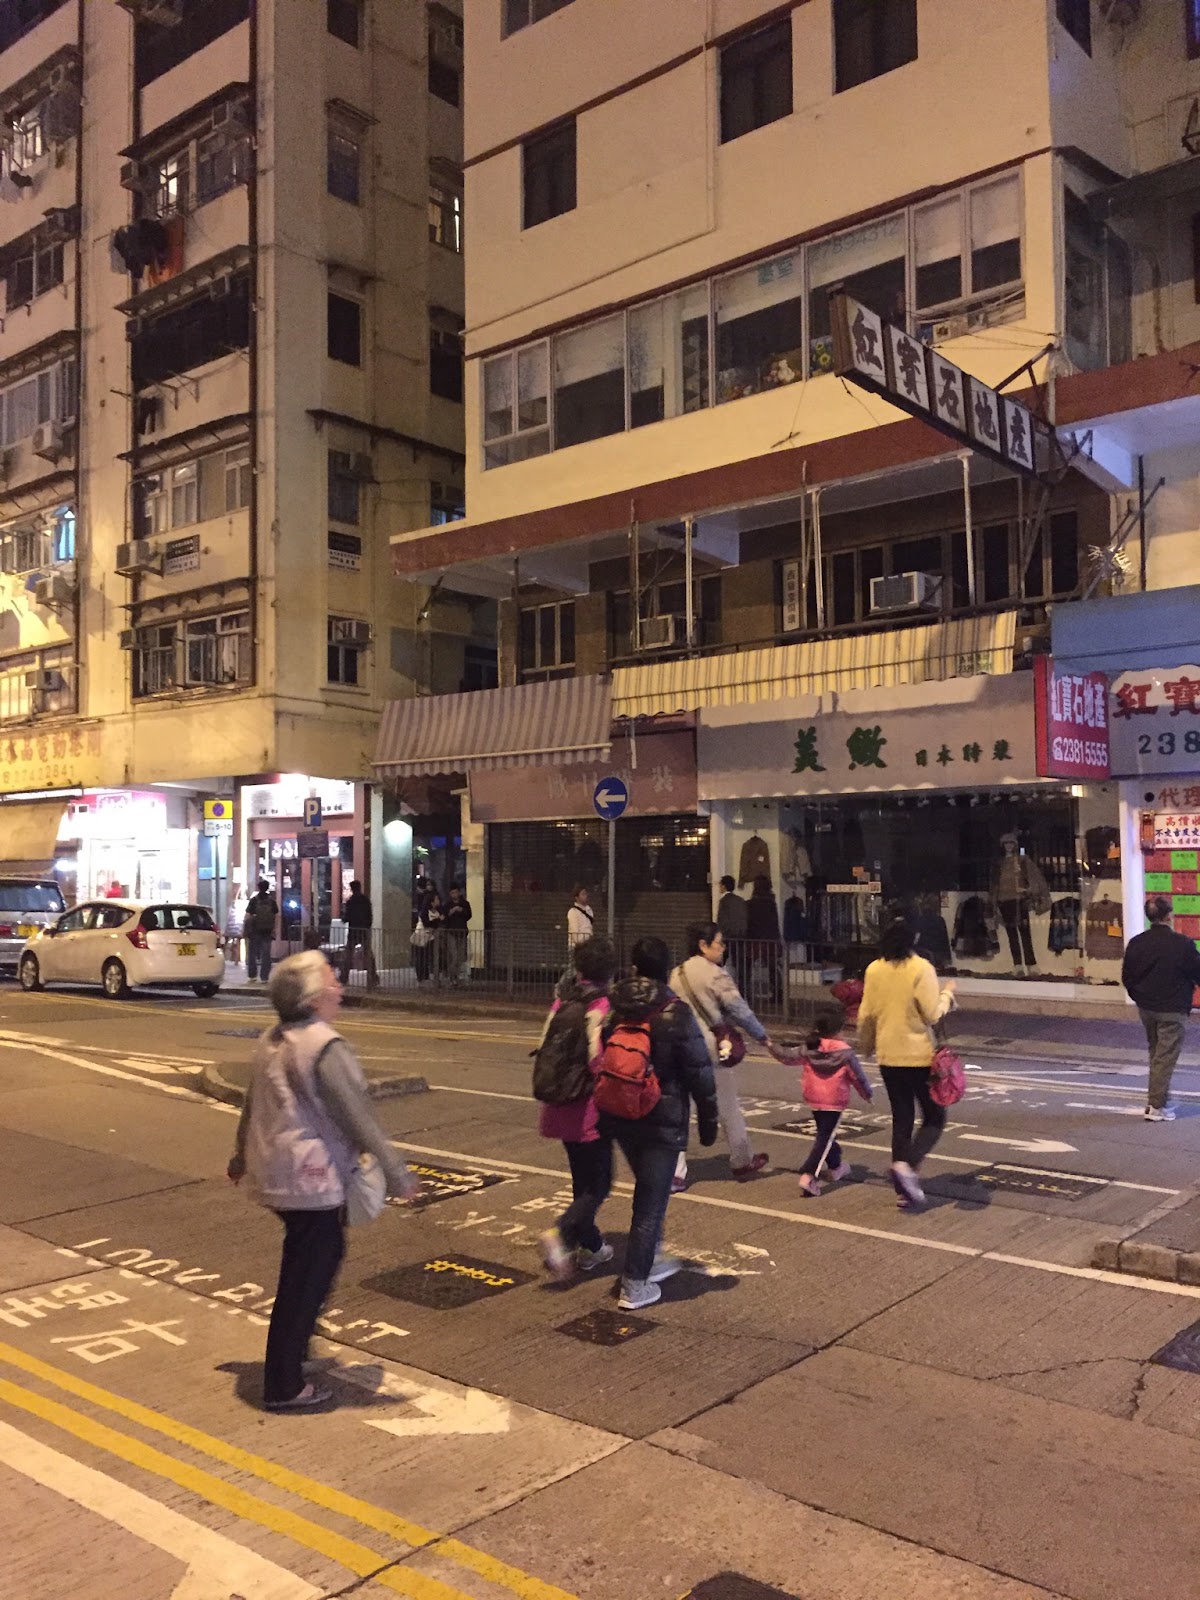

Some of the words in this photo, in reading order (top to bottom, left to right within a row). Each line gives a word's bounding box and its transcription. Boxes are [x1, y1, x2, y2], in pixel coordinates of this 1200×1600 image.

[851, 307, 1031, 463] 紅寶石地產
[1051, 672, 1107, 728] 紅寶石地產
[913, 738, 1013, 767] 日本時裝
[1063, 737, 1108, 767] 23815555
[306, 800, 319, 825] P
